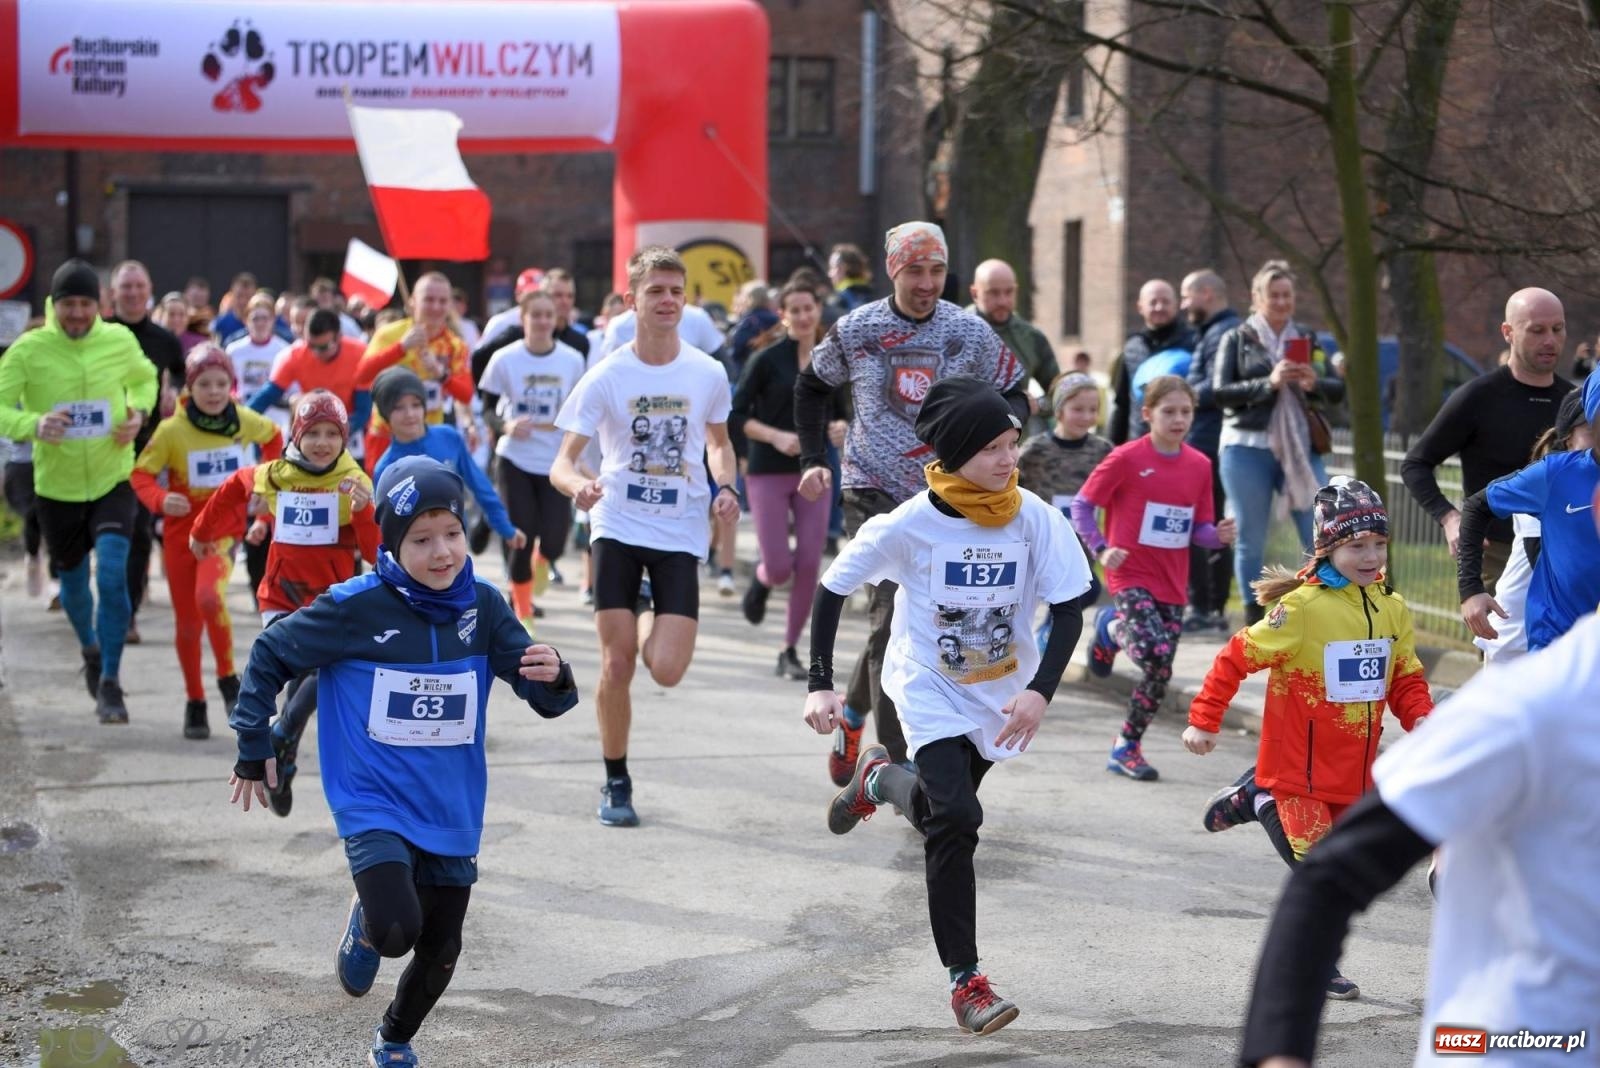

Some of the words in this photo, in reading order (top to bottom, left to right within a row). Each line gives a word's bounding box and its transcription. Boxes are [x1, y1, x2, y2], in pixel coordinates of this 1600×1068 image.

[72, 77, 127, 98] Kultury
[640, 488, 663, 503] 45
[294, 508, 313, 526] 20
[1165, 518, 1184, 533] 96
[976, 552, 1003, 560] WILCZYM
[961, 563, 1005, 586] 137
[1358, 658, 1380, 680] 68
[424, 683, 453, 692] WILCZYM
[412, 695, 445, 719] 63
